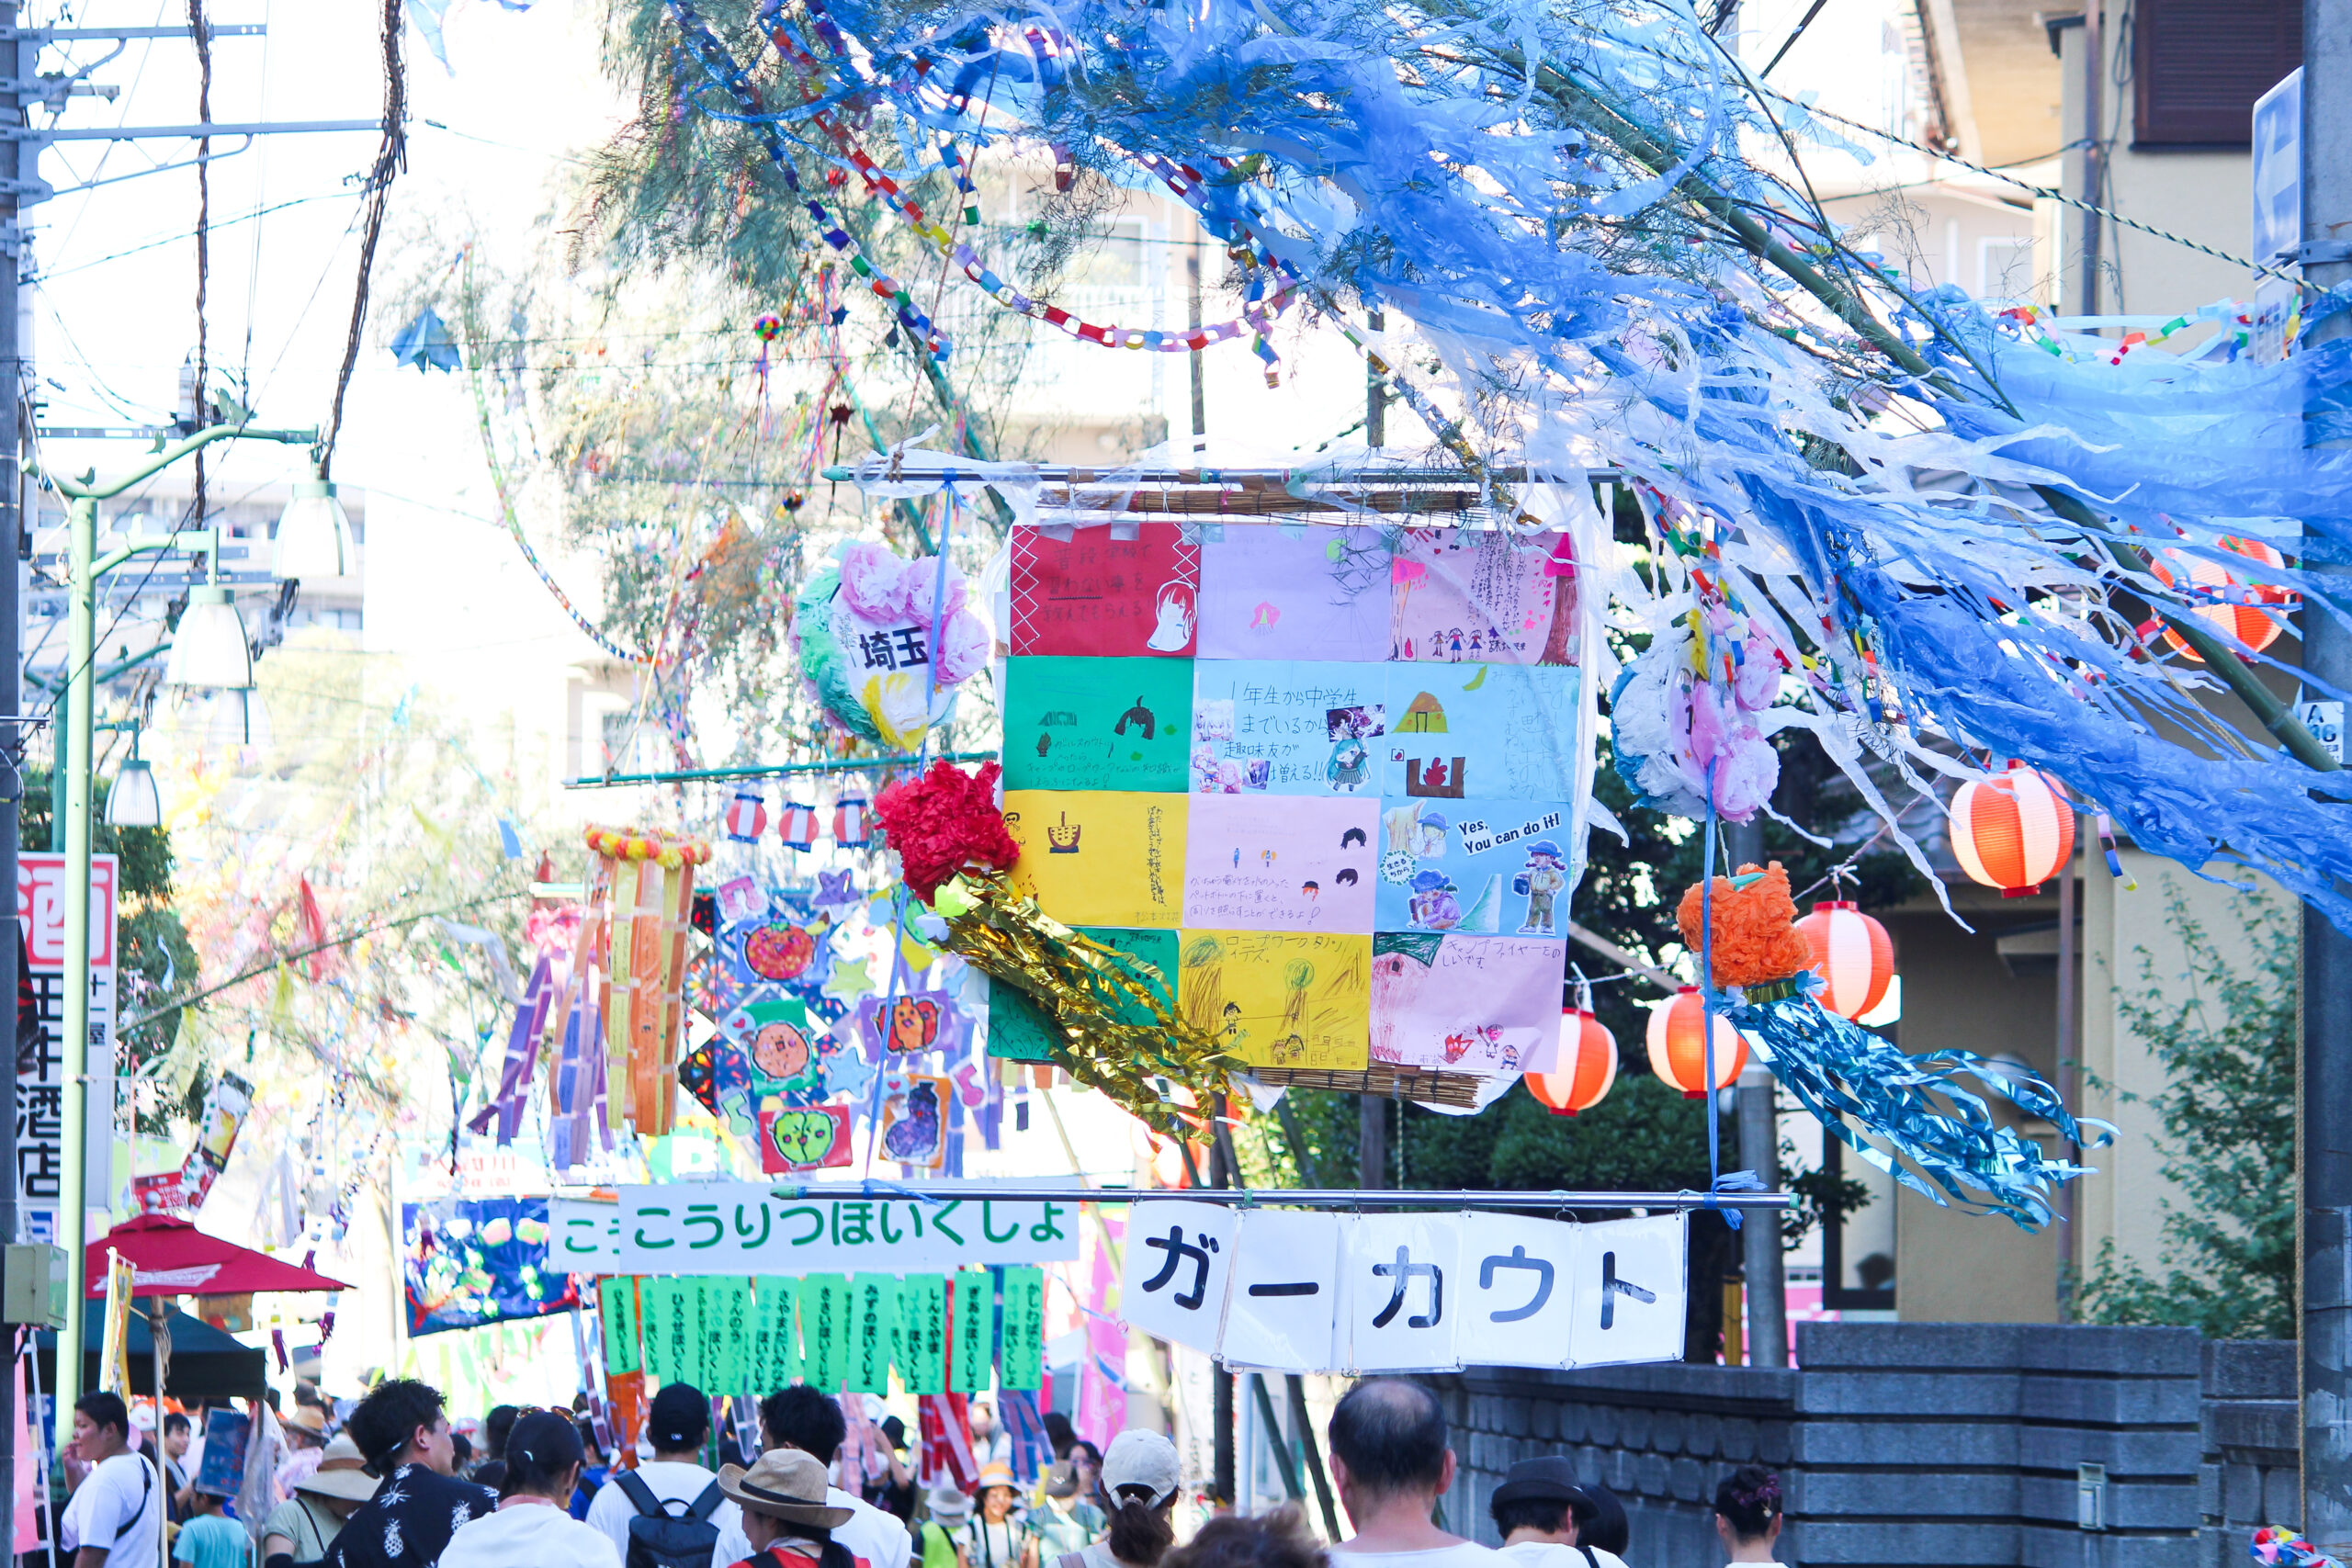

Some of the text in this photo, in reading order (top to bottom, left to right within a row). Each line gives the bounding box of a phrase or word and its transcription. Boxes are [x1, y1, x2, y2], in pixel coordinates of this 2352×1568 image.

[859, 626, 930, 671] 埼玉
[1241, 714, 1329, 736] までいるから
[1223, 741, 1300, 759] 趣味友が
[1458, 820, 1488, 836] Yes,
[1464, 812, 1561, 854] You can do it!
[1386, 858, 1408, 870] 生きる
[1390, 866, 1410, 878] ちから
[1142, 1225, 1657, 1331] ガーカウト
[671, 1293, 685, 1382] ひろせほいくし
